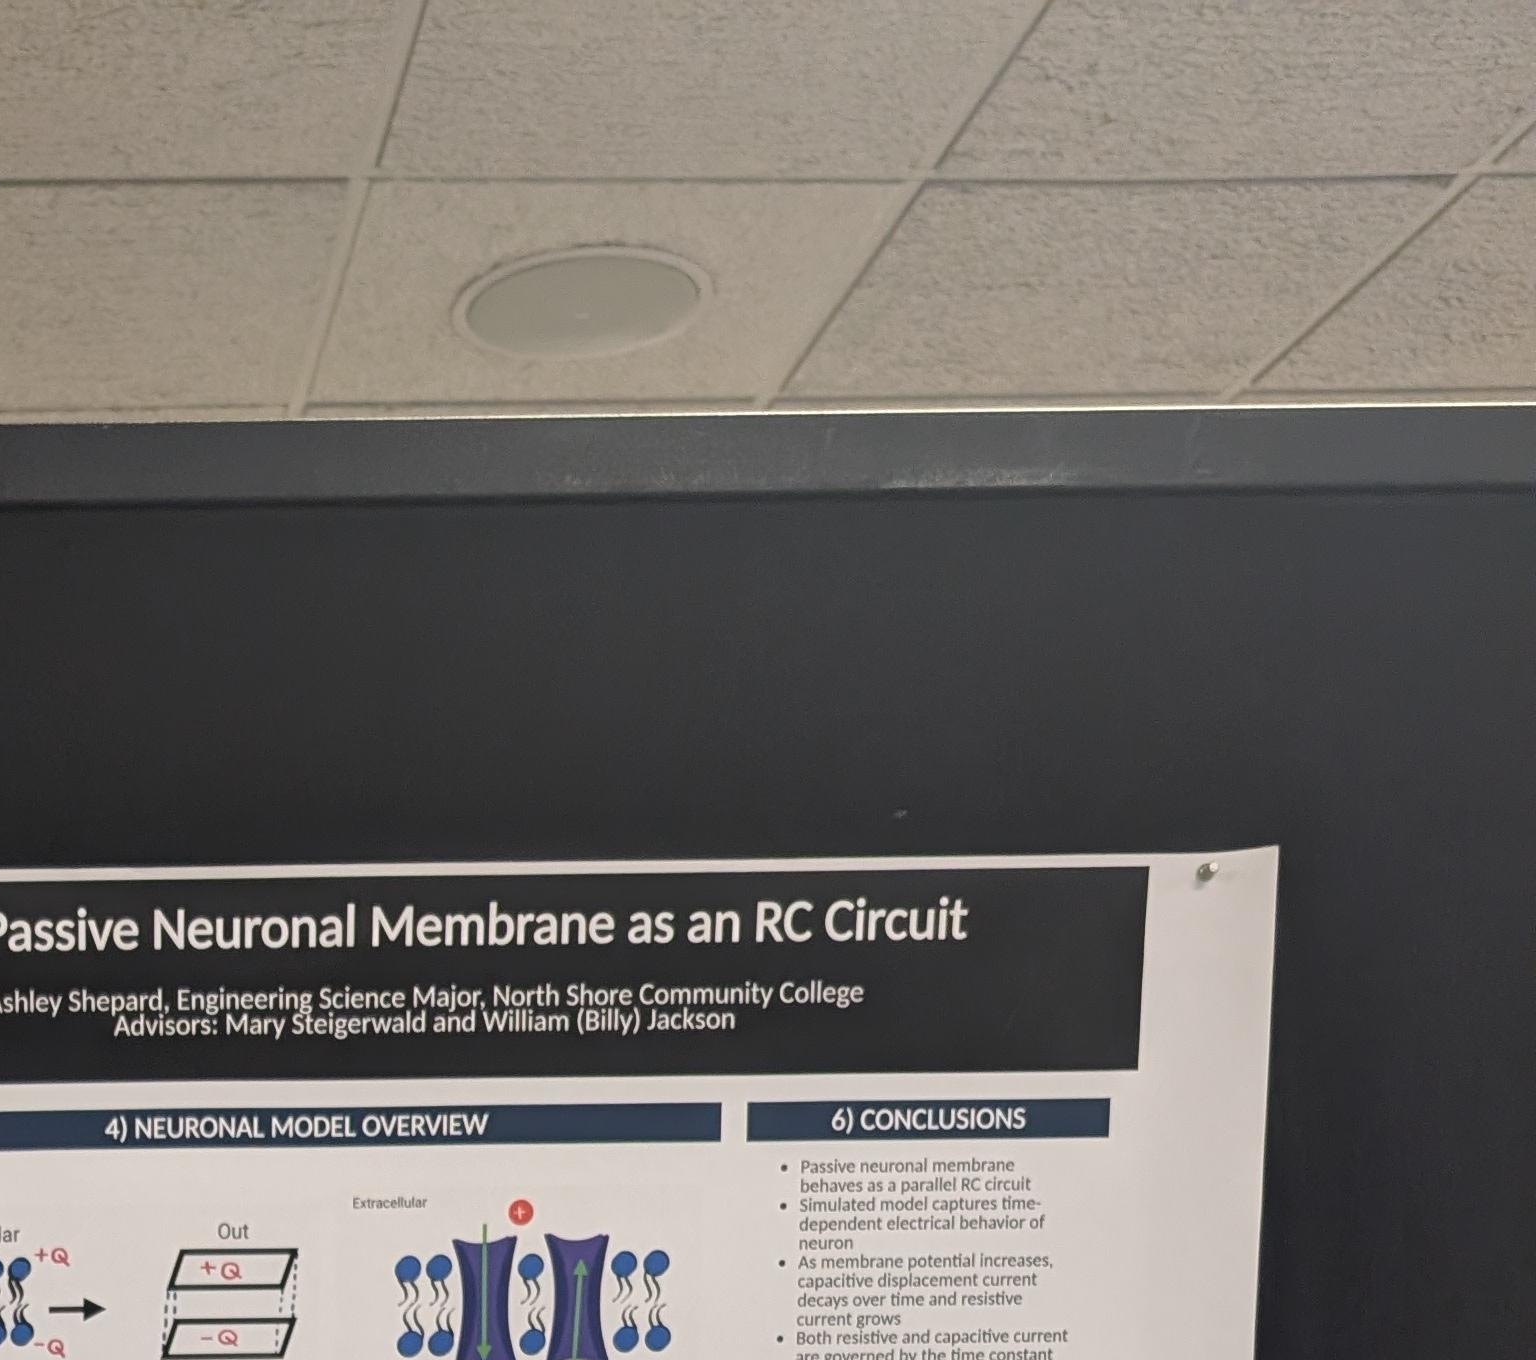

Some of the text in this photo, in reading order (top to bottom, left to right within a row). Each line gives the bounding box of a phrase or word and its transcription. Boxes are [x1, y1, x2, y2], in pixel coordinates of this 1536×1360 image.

[154, 903, 355, 950] Neuronal
[372, 902, 614, 947] Membrane
[628, 912, 674, 943] as
[688, 911, 740, 943] an
[756, 901, 813, 942] RC
[825, 896, 968, 941] Circuit
[69, 988, 169, 1014] Shepard,
[178, 987, 312, 1014] Engineering
[319, 986, 405, 1010] Science
[414, 985, 485, 1012] Major,
[494, 984, 559, 1007] North
[567, 983, 632, 1006] Shore
[640, 981, 773, 1008] Community
[780, 980, 863, 1008] College
[114, 1007, 735, 1040] Advisors: Mary Steigerwald and William (Billy) Jackson
[105, 1114, 488, 1143] 4) NEURONAL MODEL OVERVIEW
[832, 1107, 1025, 1134] 6) CONCLUSIONS
[801, 1158, 1014, 1173] Passive neuronal membrane
[801, 1176, 1031, 1195] behaves as a parallel RC circuit
[352, 1196, 427, 1209] Extracellular
[800, 1196, 1040, 1214] Simulated model captures time-
[218, 1223, 248, 1240] Out
